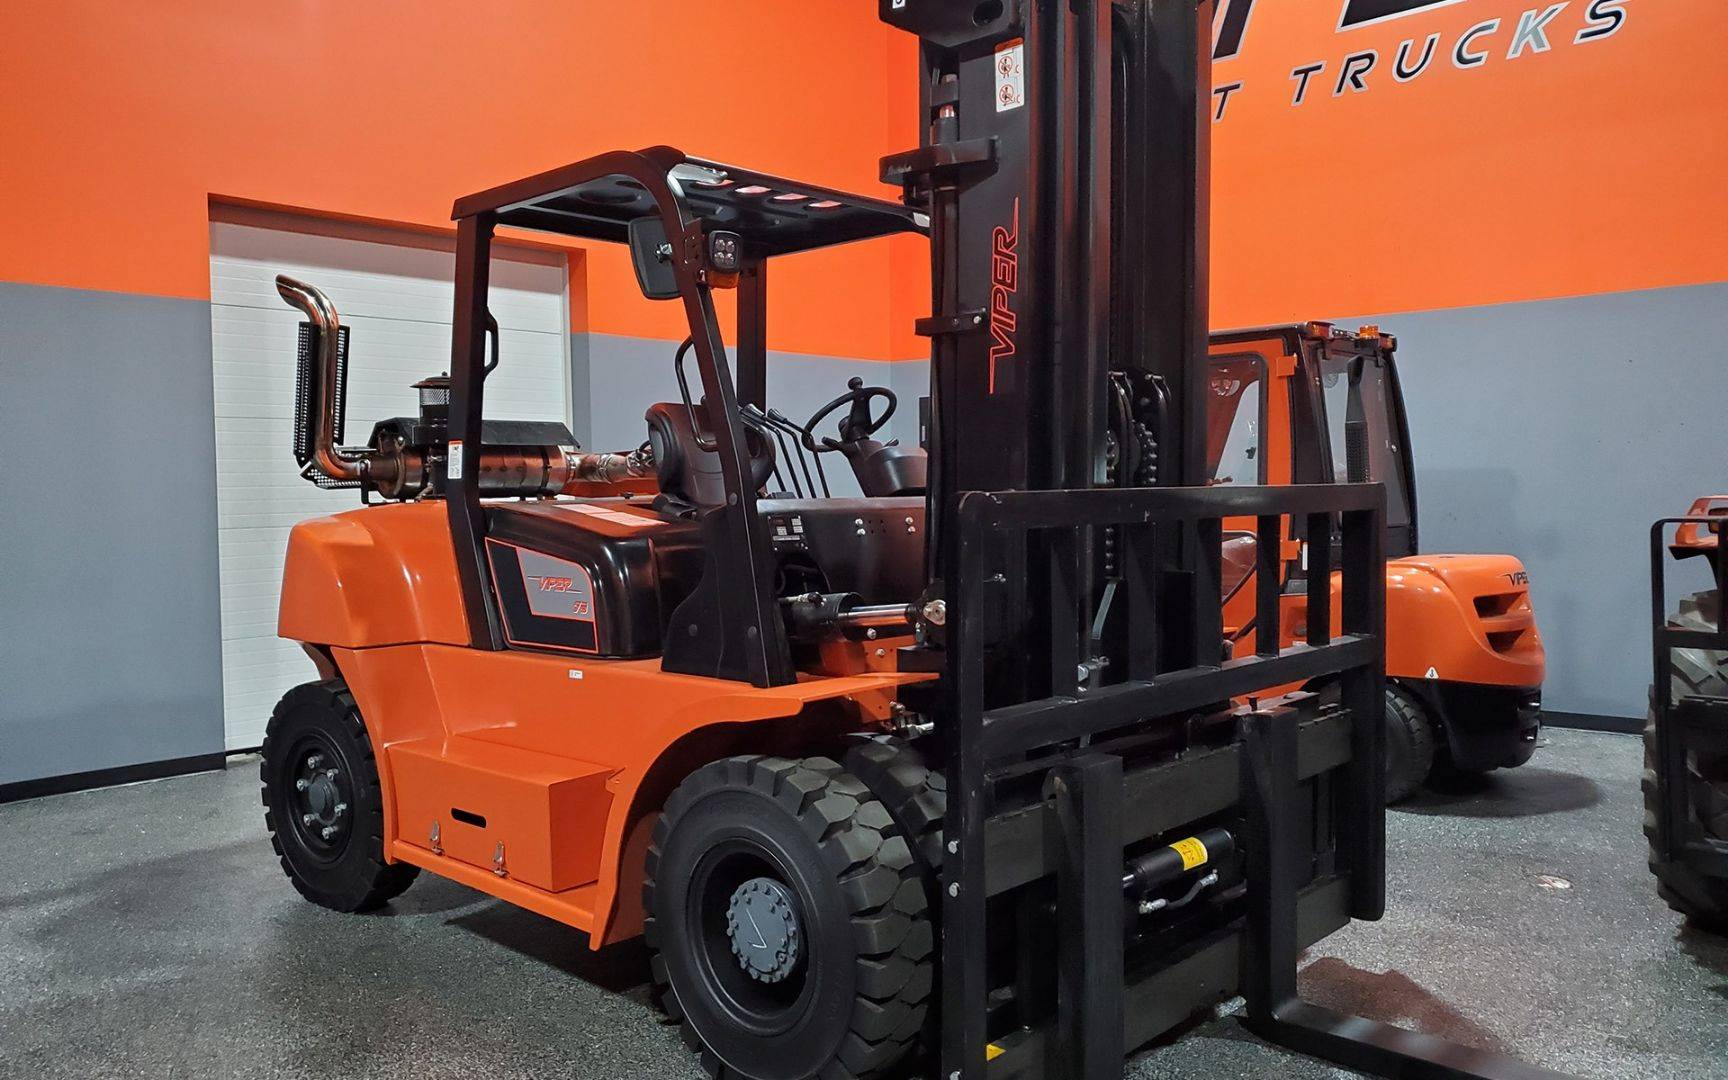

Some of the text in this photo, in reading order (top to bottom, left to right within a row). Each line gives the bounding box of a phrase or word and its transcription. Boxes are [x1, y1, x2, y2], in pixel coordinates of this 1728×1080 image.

[1289, 0, 1630, 107] TRUCKS
[989, 197, 1019, 394] VIPER
[528, 575, 582, 594] VIPER
